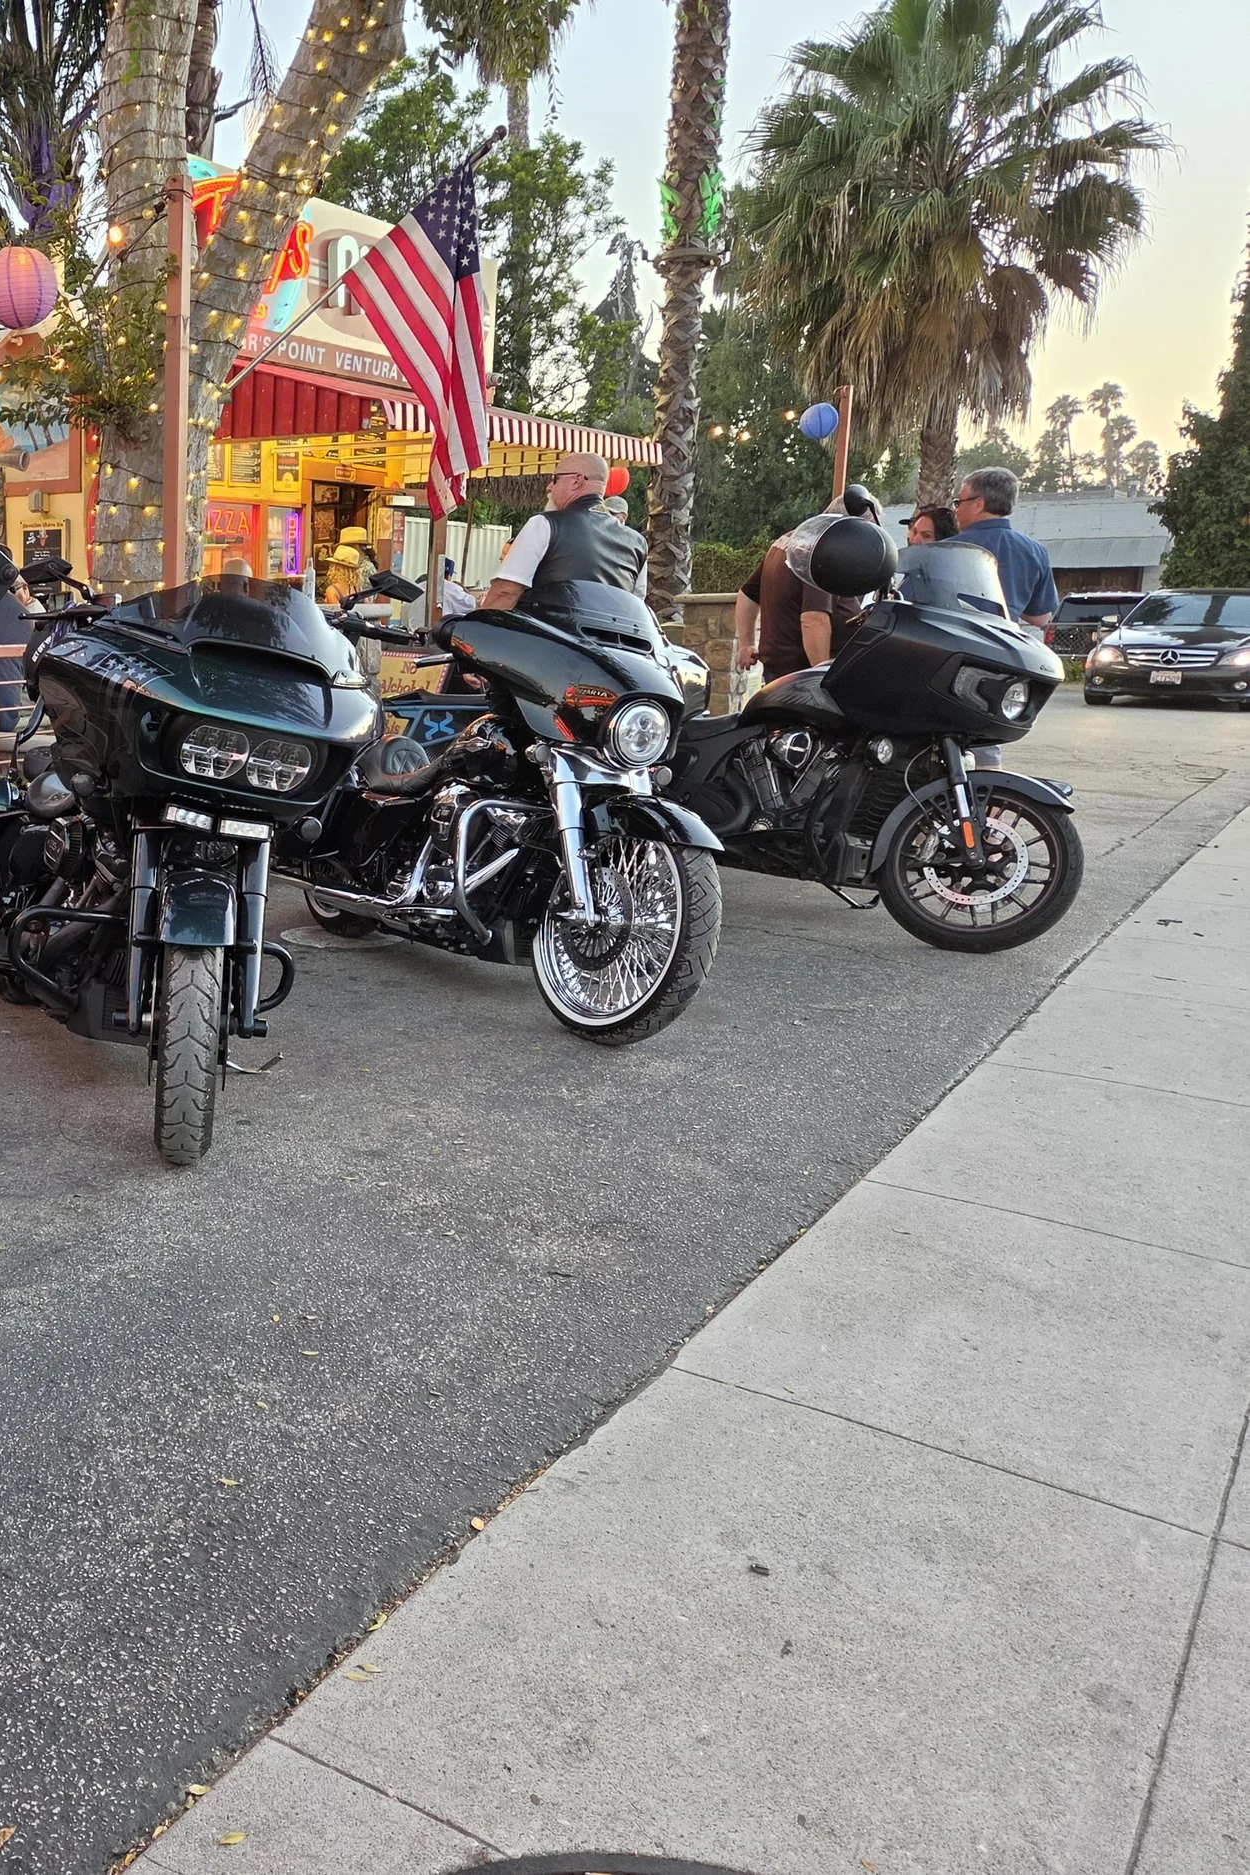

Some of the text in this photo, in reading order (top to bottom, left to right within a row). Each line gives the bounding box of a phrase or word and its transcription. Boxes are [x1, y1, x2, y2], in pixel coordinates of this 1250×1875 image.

[277, 340, 326, 365] POINT
[335, 351, 398, 380] VENTURA
[205, 509, 251, 535] IZZA
[287, 517, 297, 570] OPEN
